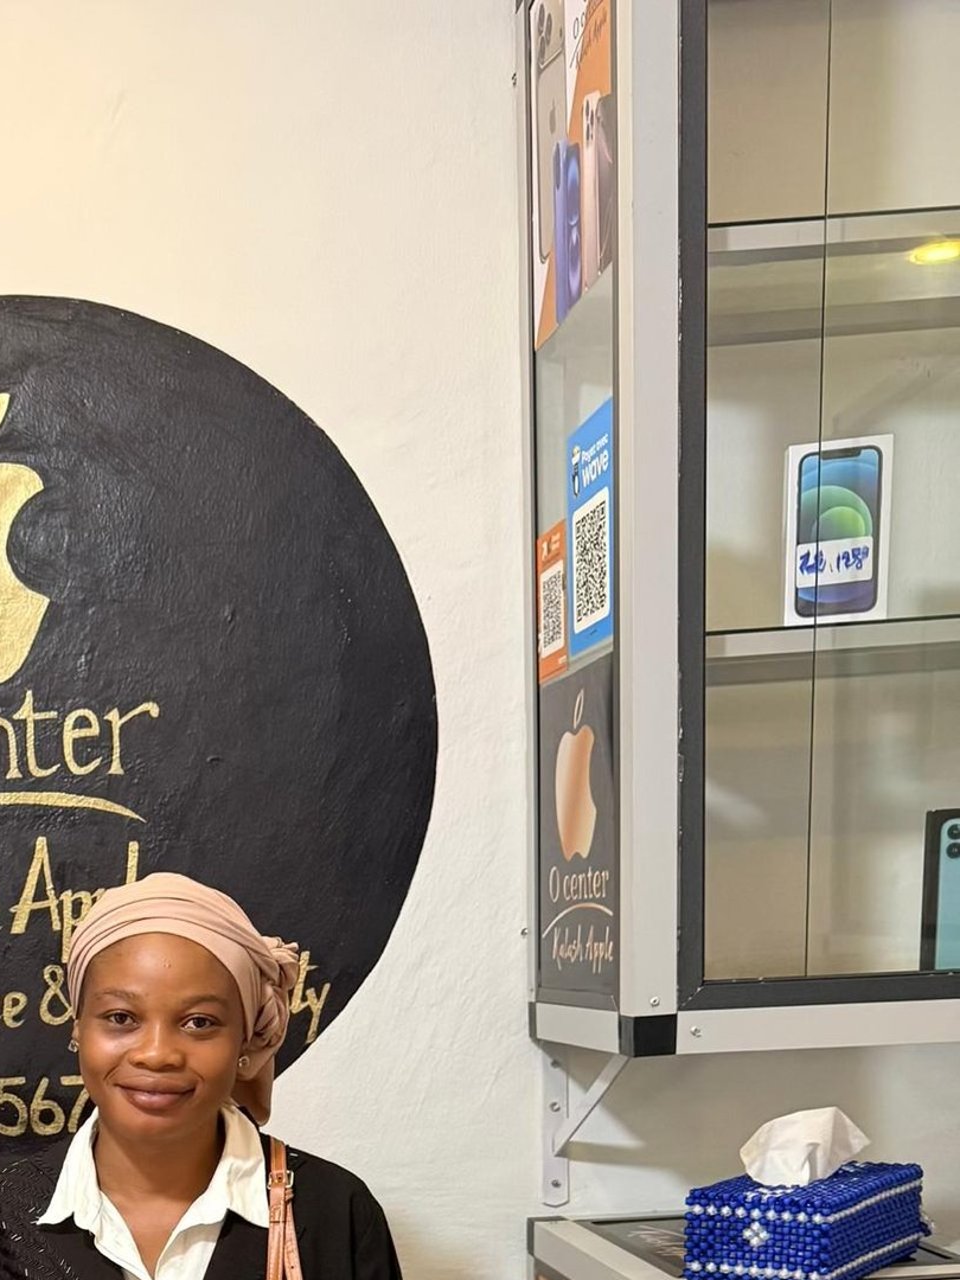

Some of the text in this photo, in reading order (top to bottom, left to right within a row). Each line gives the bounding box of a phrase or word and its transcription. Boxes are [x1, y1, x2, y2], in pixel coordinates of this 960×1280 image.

[581, 450, 609, 488] wave
[549, 865, 610, 904] O center
[552, 924, 614, 975] Kalash Apple
[39, 964, 76, 1026] &
